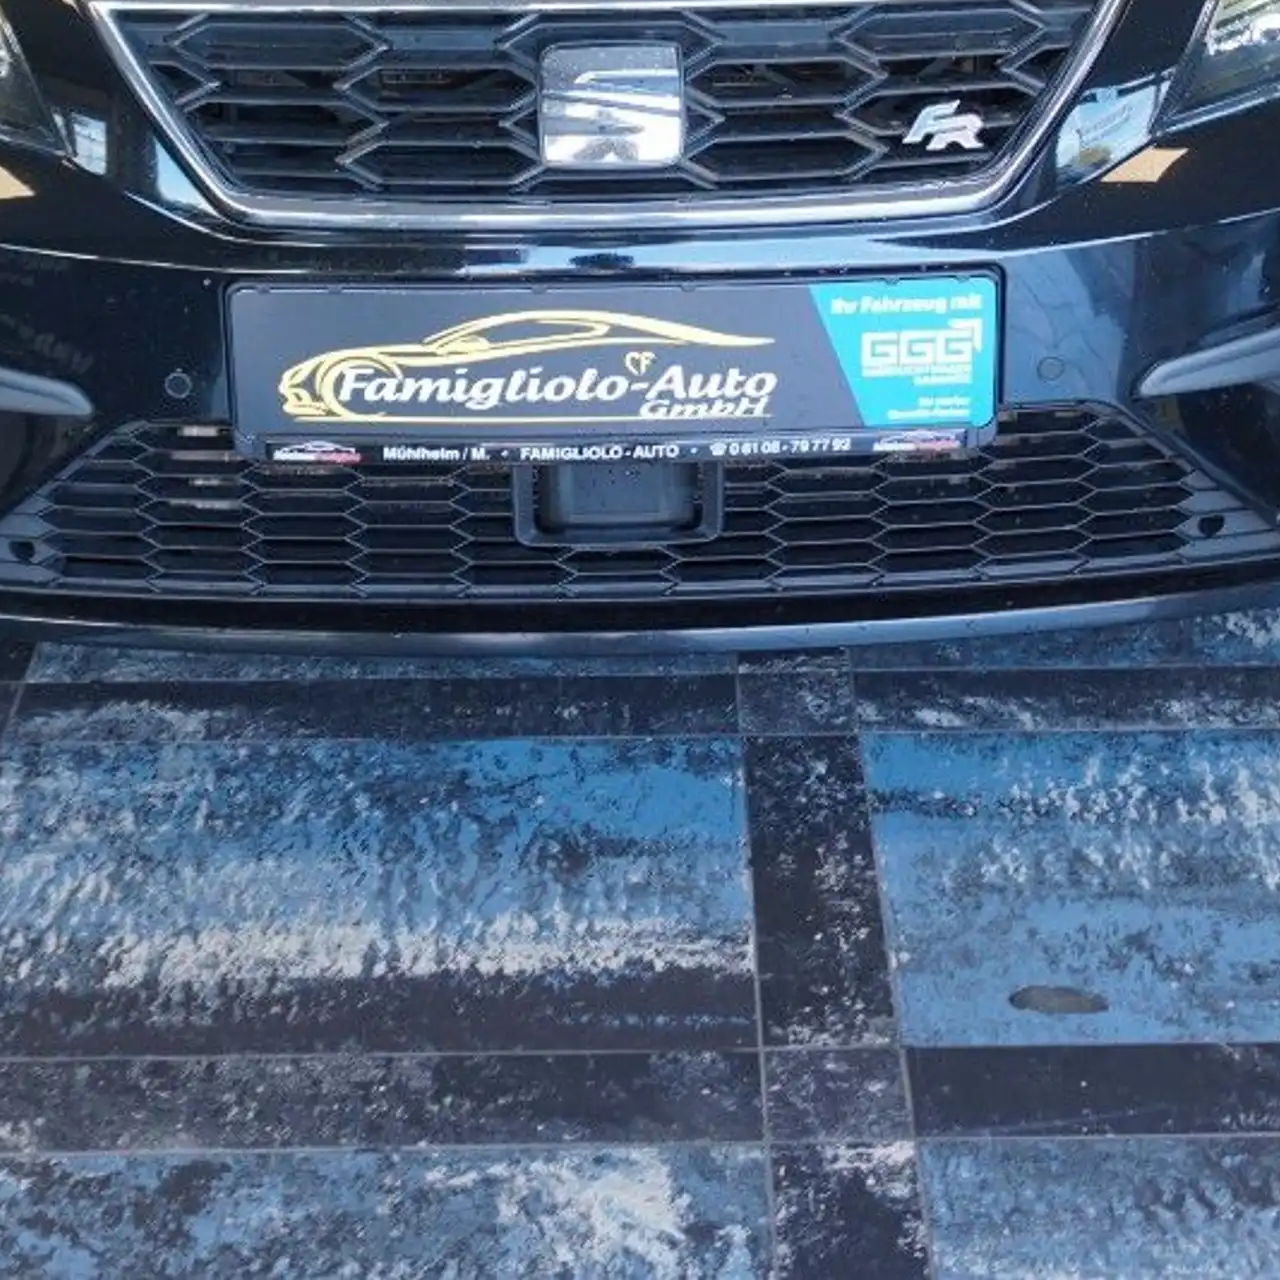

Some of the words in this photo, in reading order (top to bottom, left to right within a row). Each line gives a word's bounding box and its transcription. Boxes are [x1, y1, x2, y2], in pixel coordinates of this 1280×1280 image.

[902, 99, 984, 151] FR
[861, 328, 972, 368] GGG
[339, 365, 778, 411] Famigliolo-Auto
[639, 396, 769, 419] GmbH
